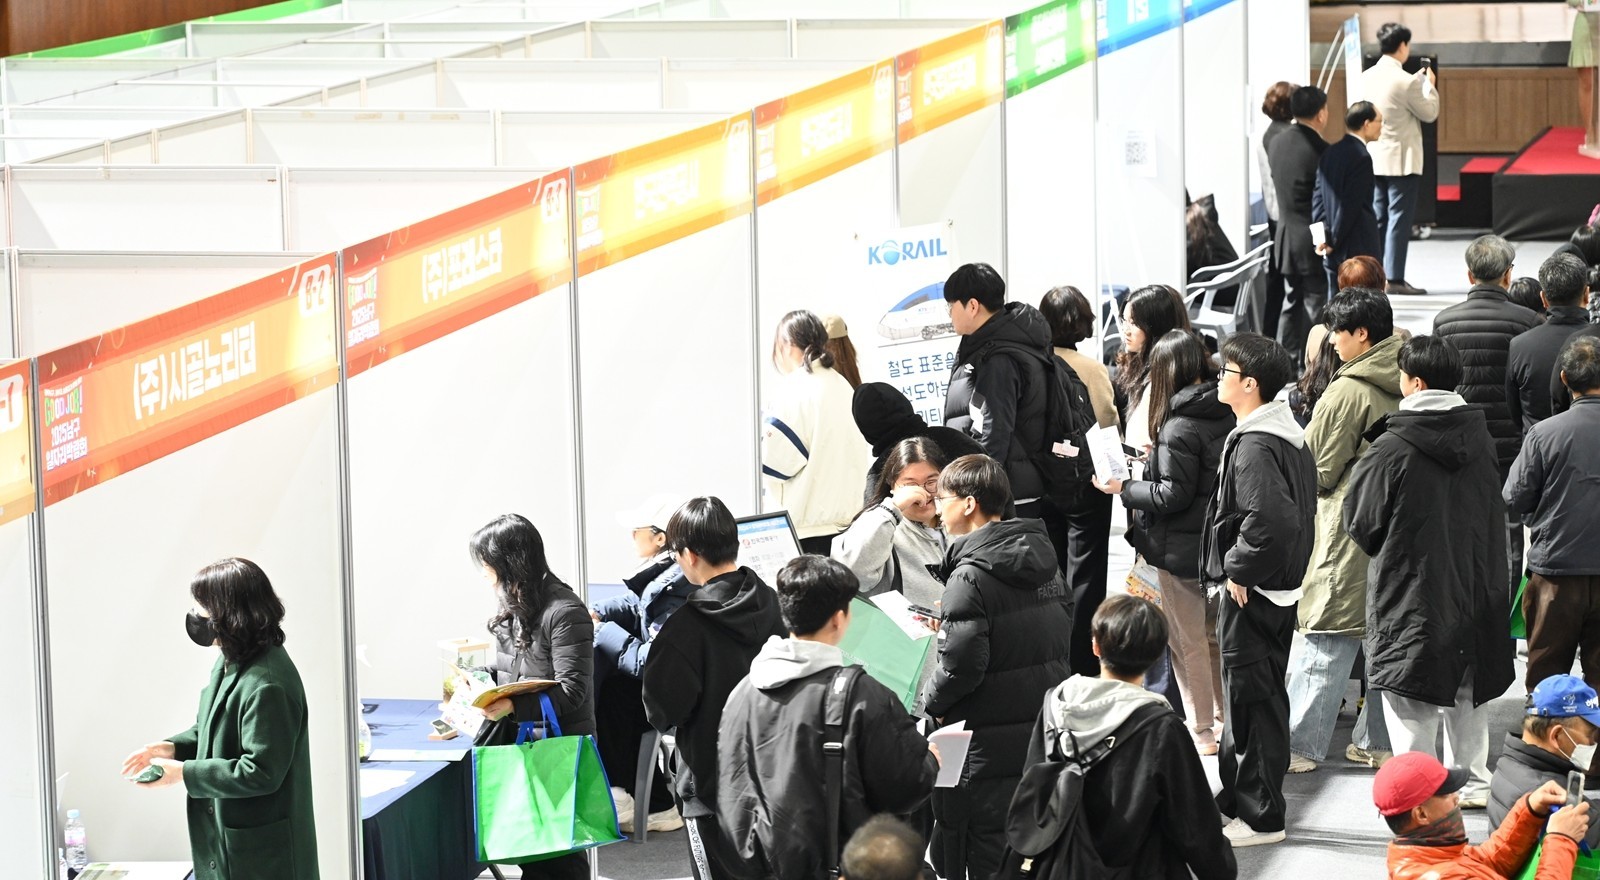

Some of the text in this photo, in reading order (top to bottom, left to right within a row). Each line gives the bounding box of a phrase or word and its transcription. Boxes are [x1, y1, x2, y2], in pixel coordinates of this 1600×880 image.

[868, 237, 947, 266] KORAIL
[133, 320, 257, 421] (주)시골노리터
[888, 351, 955, 378] 철도 표준을
